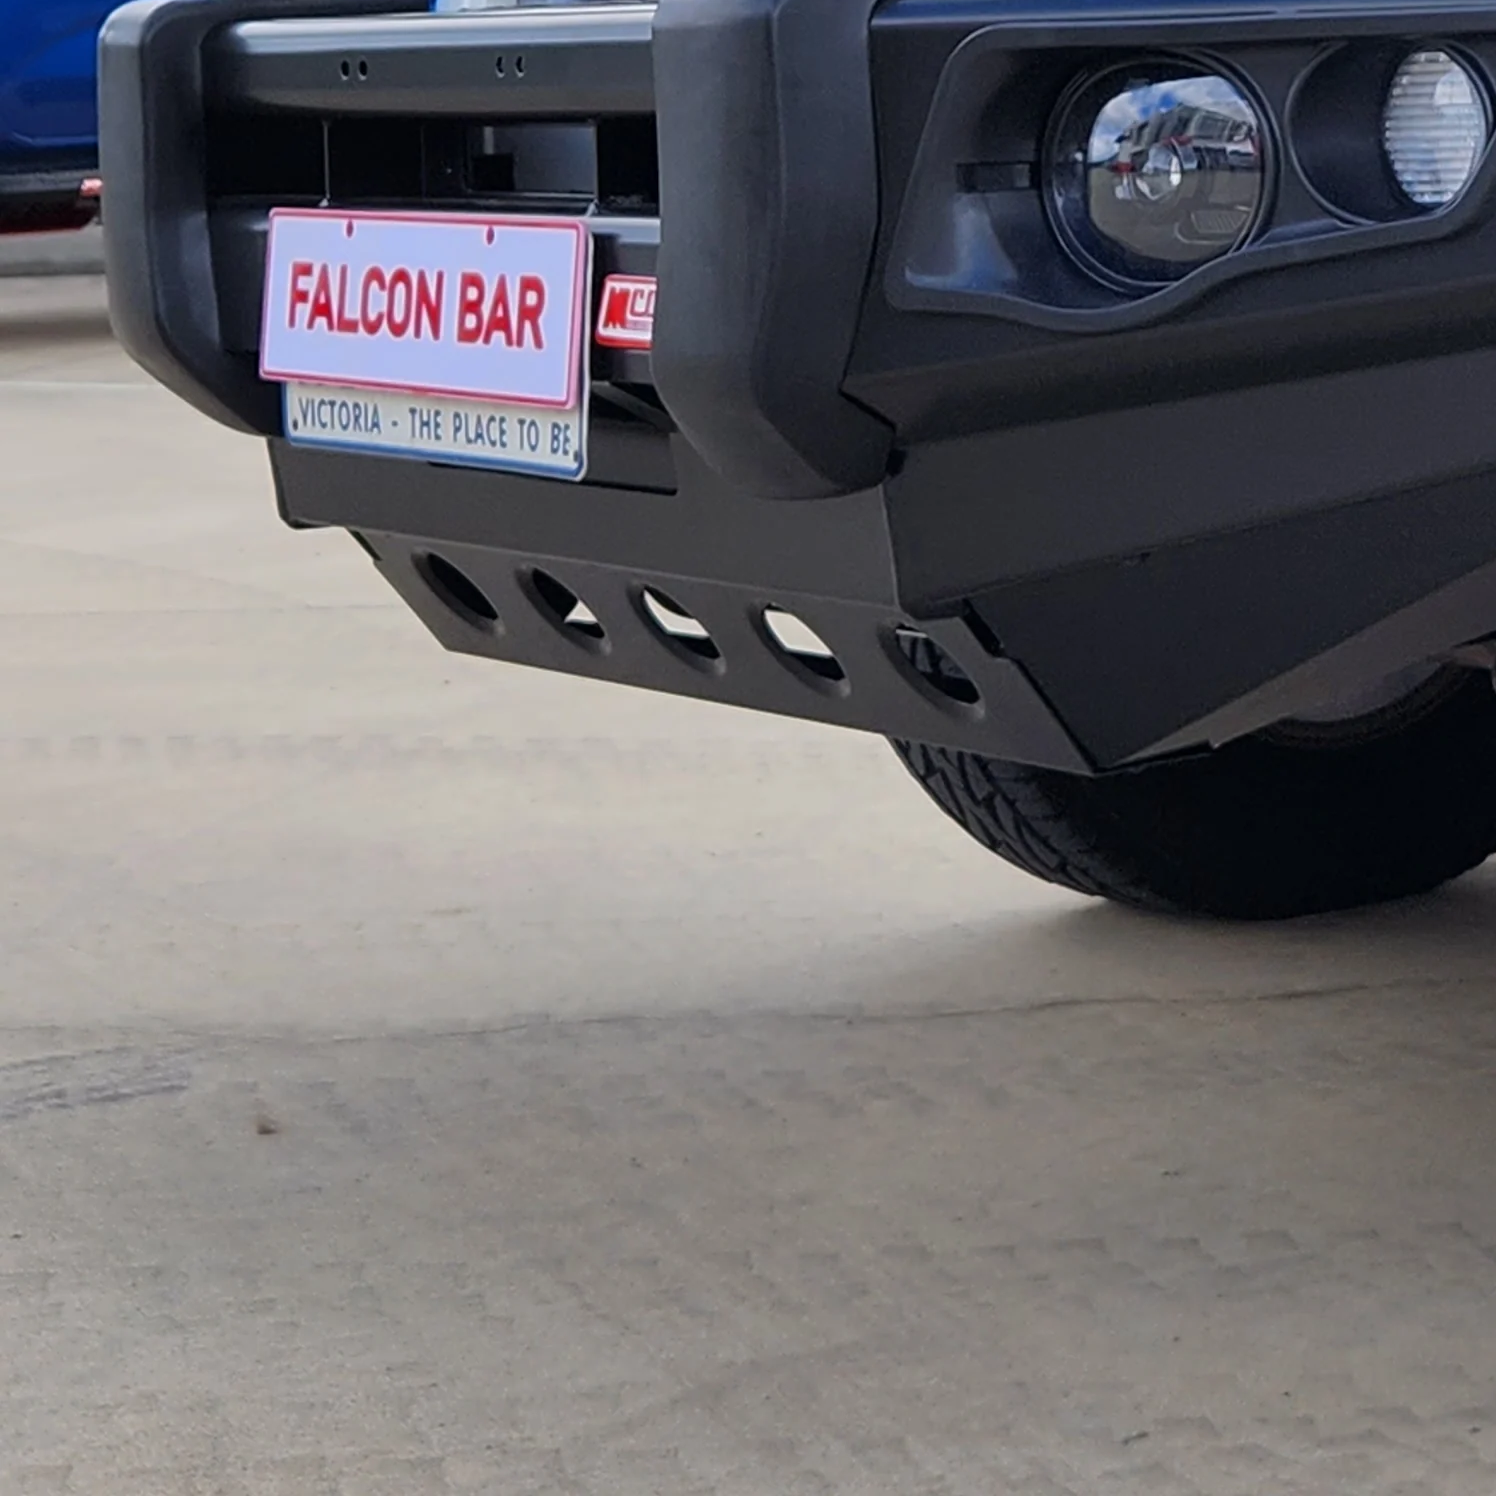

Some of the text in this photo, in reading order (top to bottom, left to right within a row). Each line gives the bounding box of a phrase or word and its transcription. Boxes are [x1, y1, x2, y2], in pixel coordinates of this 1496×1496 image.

[287, 260, 546, 350] FALCON BAR
[298, 398, 381, 434] VICTORIA
[408, 407, 442, 441] THE
[453, 411, 507, 448] PLACE
[517, 418, 539, 453] TO
[551, 422, 571, 456] BE
